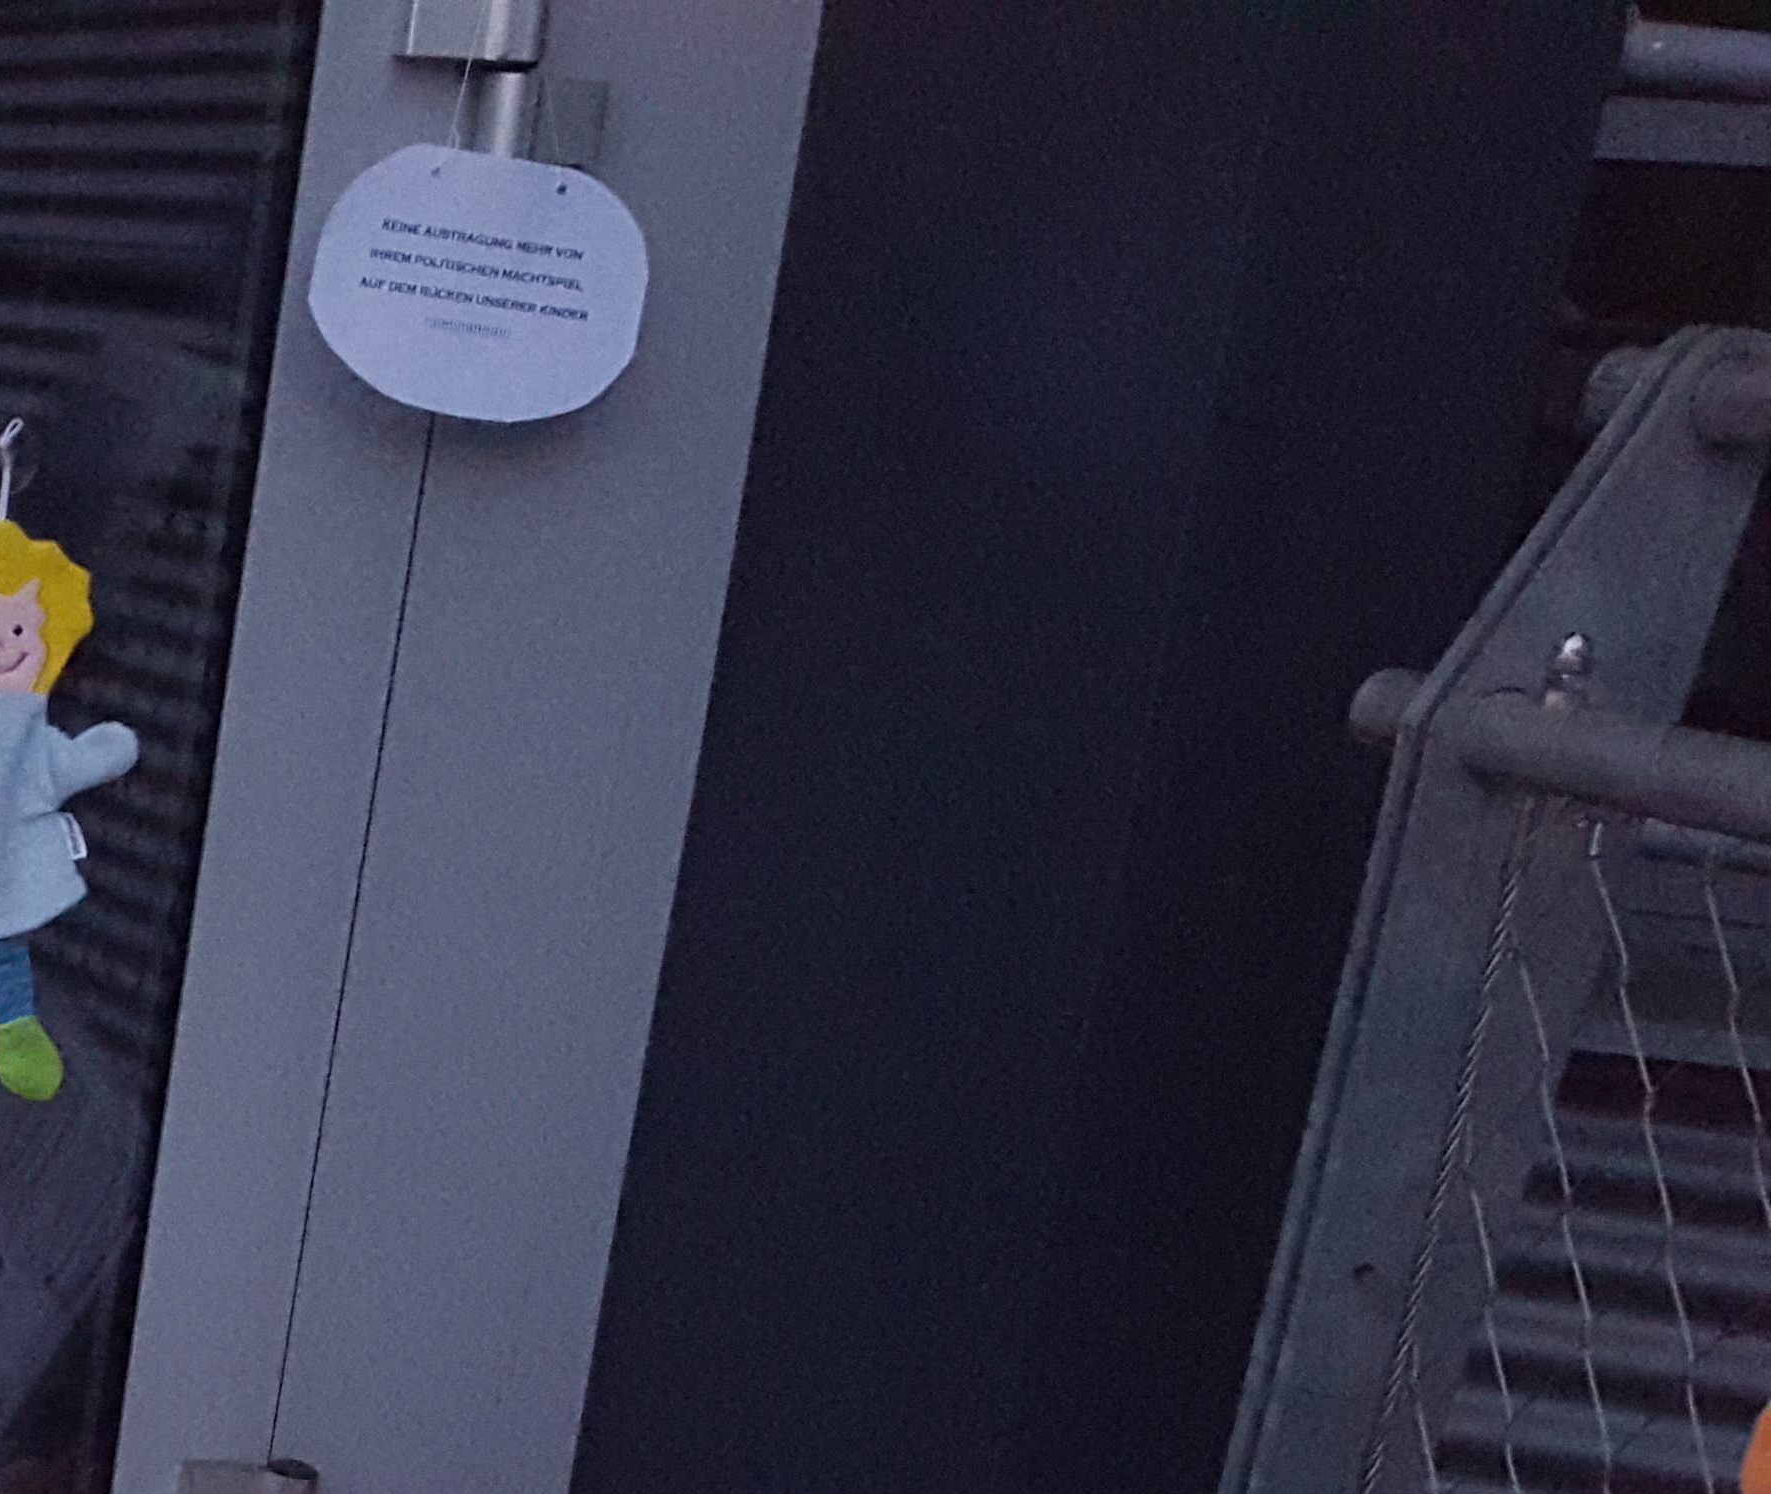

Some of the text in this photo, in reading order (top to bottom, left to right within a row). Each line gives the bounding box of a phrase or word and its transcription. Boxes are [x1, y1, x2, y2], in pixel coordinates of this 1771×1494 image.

[382, 218, 584, 261] KEINE AUSTRAGUNG MEHR VON
[370, 249, 584, 293] IHREM POLITISCHEN MACHTSPIEL
[361, 277, 589, 321] AUF DEM RÜCKEN UNSERER KINDER
